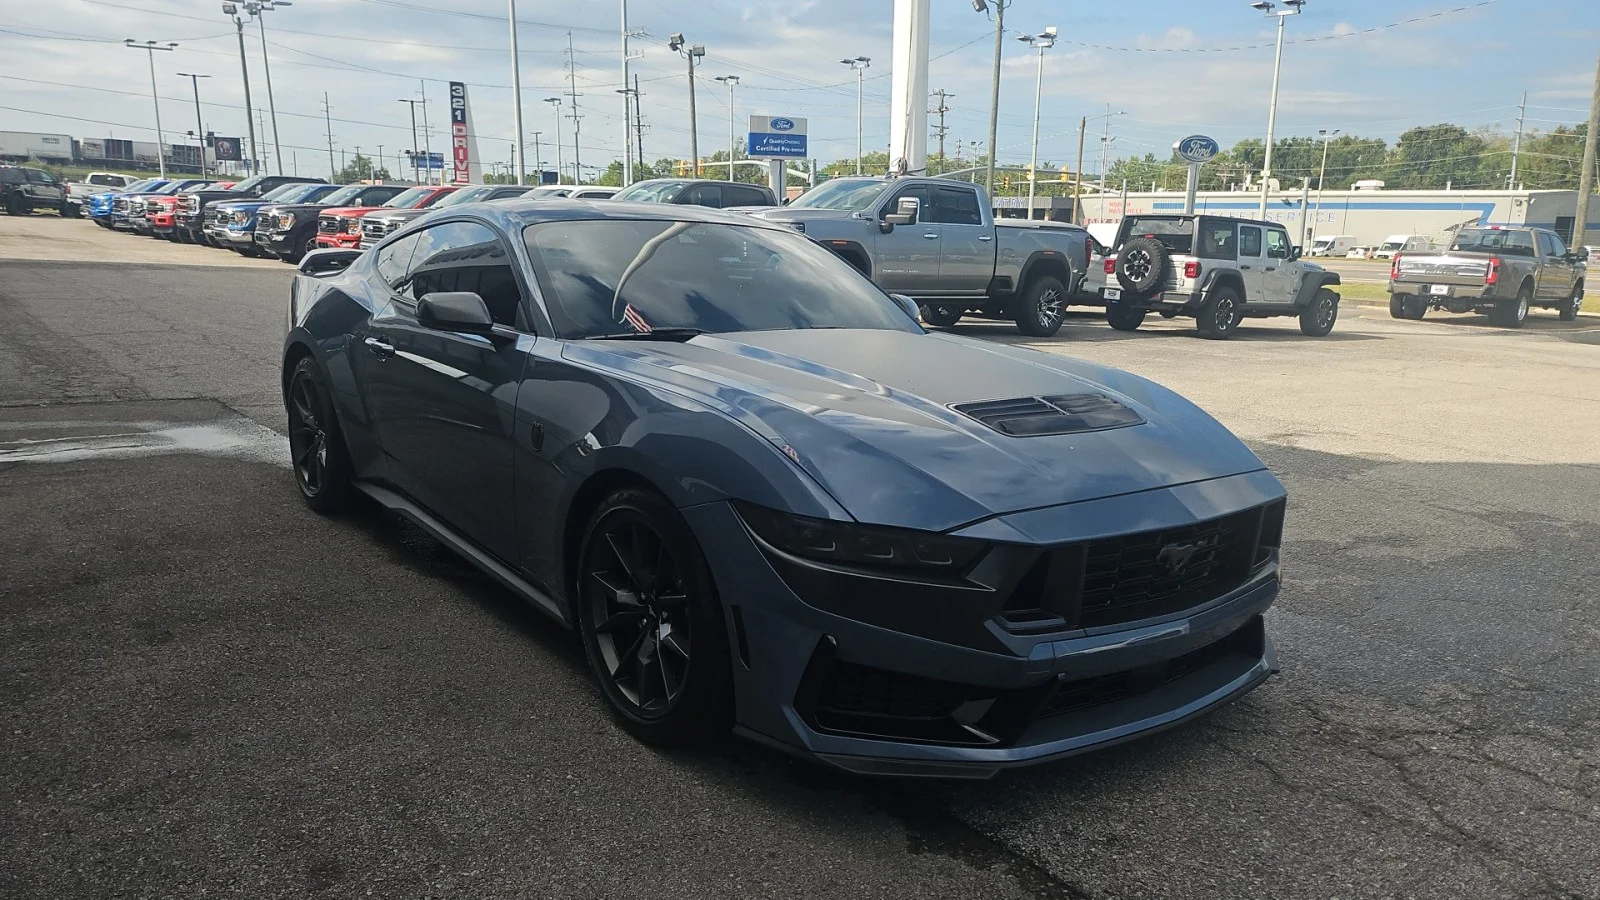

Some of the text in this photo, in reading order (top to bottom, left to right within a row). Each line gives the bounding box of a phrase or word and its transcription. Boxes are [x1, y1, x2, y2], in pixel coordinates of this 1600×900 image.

[451, 85, 469, 182] 321 DRIVE
[1187, 140, 1213, 157] Ford
